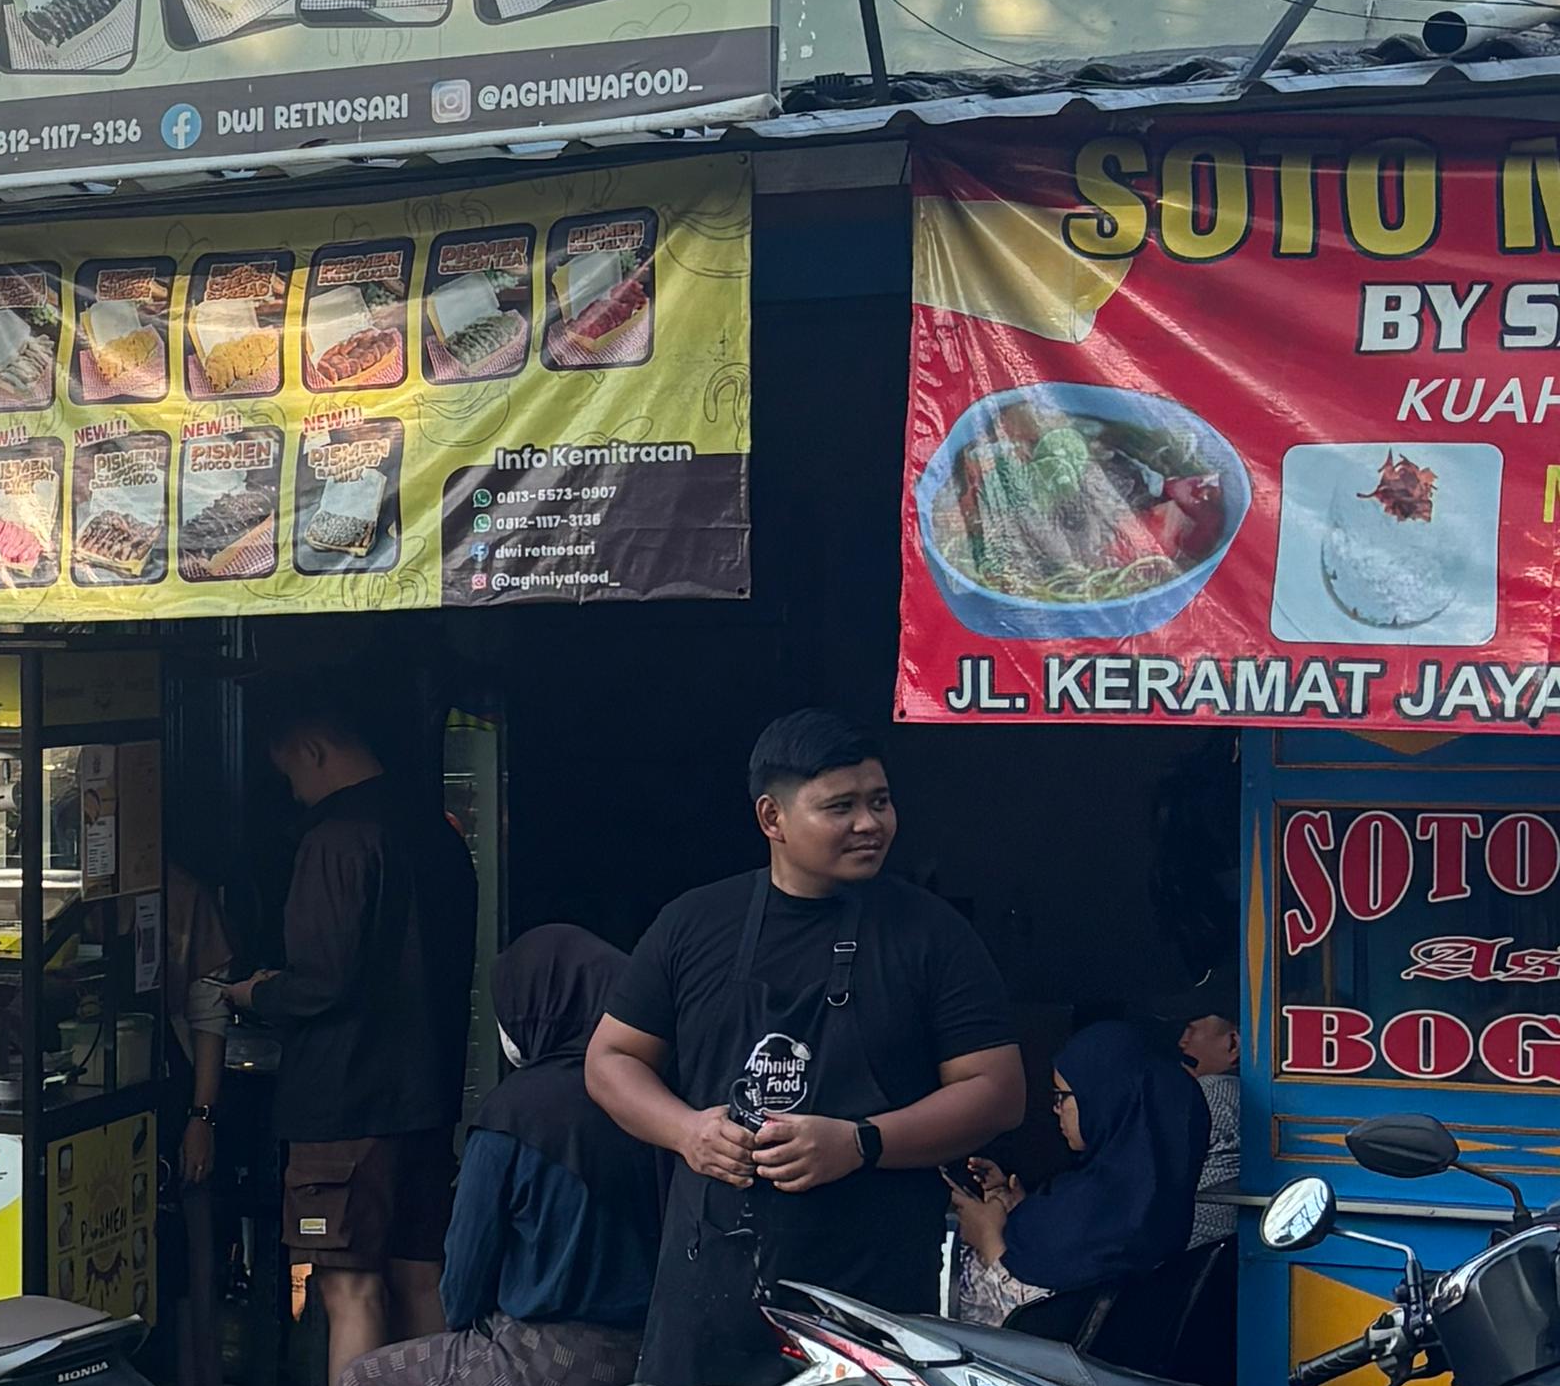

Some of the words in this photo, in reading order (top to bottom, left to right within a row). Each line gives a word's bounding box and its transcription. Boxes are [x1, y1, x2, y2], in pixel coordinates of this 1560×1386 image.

[216, 105, 265, 136] DWI
[274, 93, 409, 131] RETNOSARI
[1063, 134, 1441, 263] SOTO
[1358, 281, 1493, 353] BY
[1501, 281, 1560, 353] S
[1397, 378, 1560, 424] KUAH
[74, 419, 128, 445] NEW!!!
[183, 413, 242, 439] NEW!!!
[303, 407, 364, 434] NEW!!!
[191, 441, 272, 462] PISMEN
[309, 440, 389, 467] PISMEN
[496, 447, 548, 470] Info
[551, 442, 693, 467] Kemitraan
[191, 460, 230, 472] CHOCO
[495, 544, 522, 560] dwi
[945, 657, 1027, 712] JL.
[1045, 655, 1382, 717] KERAMAT
[1398, 659, 1560, 723] JAYA
[1283, 810, 1560, 956] SOTO
[1401, 936, 1560, 982] As
[1281, 1005, 1560, 1084] BOG
[744, 1055, 806, 1078] Aghniya
[766, 1073, 801, 1093] Food
[57, 1361, 110, 1383] HONDA
